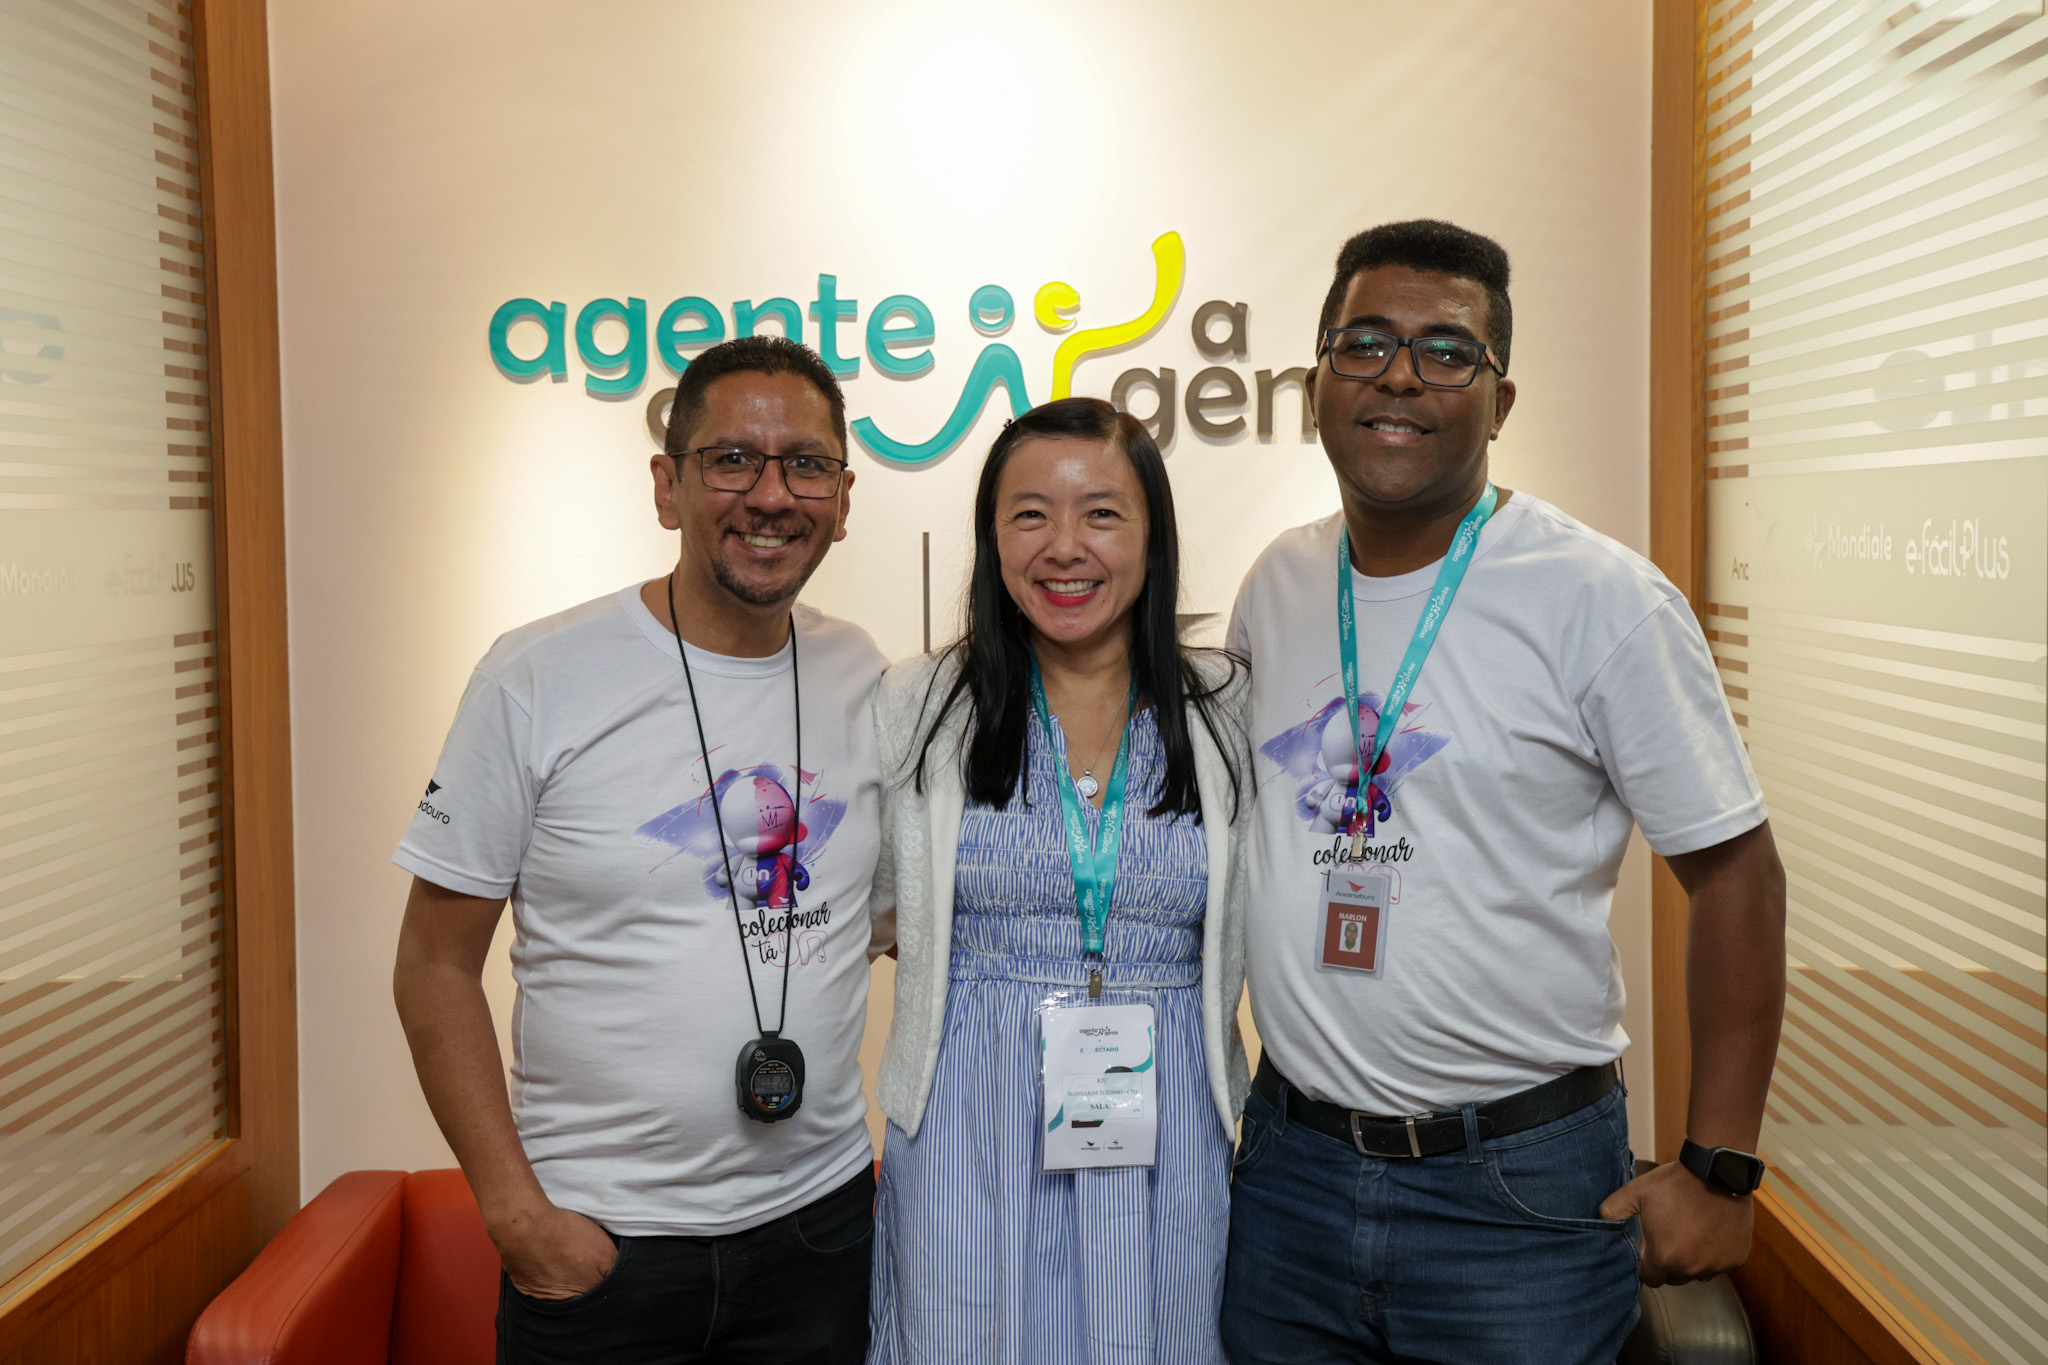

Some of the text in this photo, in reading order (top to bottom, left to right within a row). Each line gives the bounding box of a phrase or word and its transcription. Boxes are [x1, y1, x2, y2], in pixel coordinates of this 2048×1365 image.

[488, 273, 1248, 395] agente a
[1472, 515, 1483, 530] gente
[1453, 536, 1467, 561] agente
[1827, 523, 1893, 561] Mondiale
[1439, 587, 1449, 605] gente
[1420, 613, 1433, 638] agente
[1405, 663, 1415, 680] gente
[1387, 690, 1400, 715] agente
[1073, 810, 1083, 835] agente
[1102, 828, 1110, 853] agente
[1313, 835, 1414, 867] coleonar
[1075, 844, 1083, 864] gente
[1099, 879, 1107, 898] gente
[1335, 890, 1376, 901] Ancoradouro
[1087, 889, 1096, 916] agente
[1338, 912, 1368, 922] MARLON
[751, 940, 778, 964] tá
[1099, 1088, 1123, 1096] TURISMO
